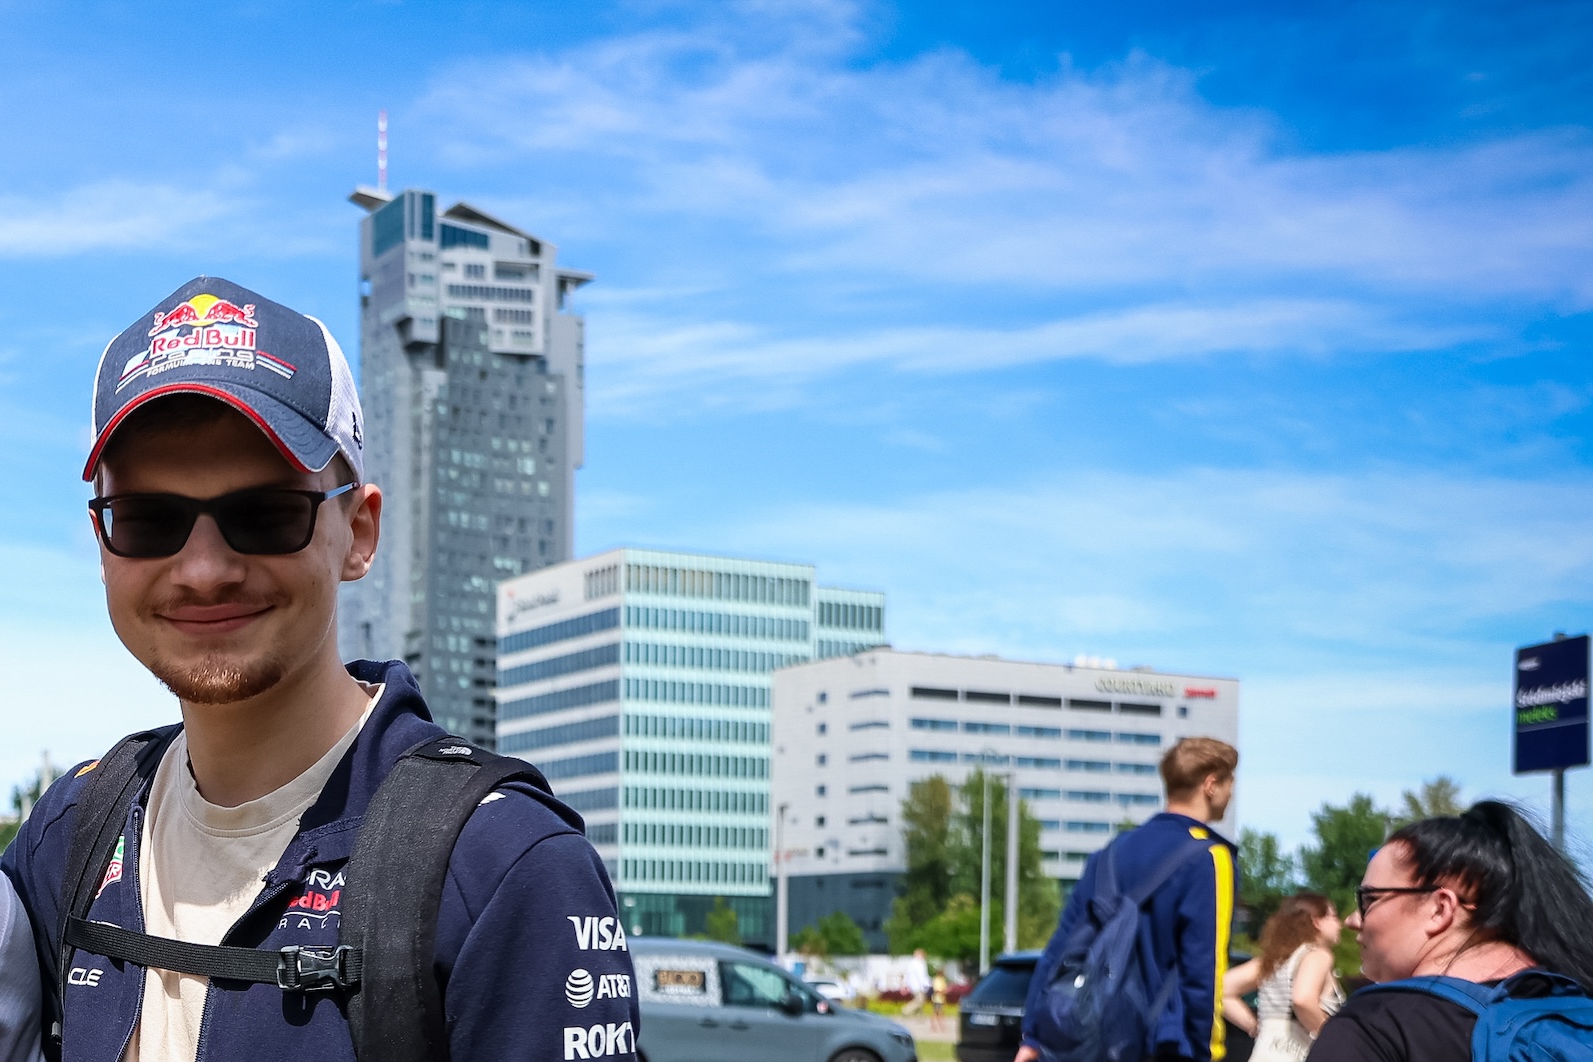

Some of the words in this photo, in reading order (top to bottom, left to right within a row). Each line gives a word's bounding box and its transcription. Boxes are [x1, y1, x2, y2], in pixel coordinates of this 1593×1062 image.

[150, 328, 201, 357] Red
[205, 327, 256, 350] Bull
[225, 359, 255, 371] TEAM
[567, 915, 628, 951] VISA
[596, 973, 631, 999] AT&T
